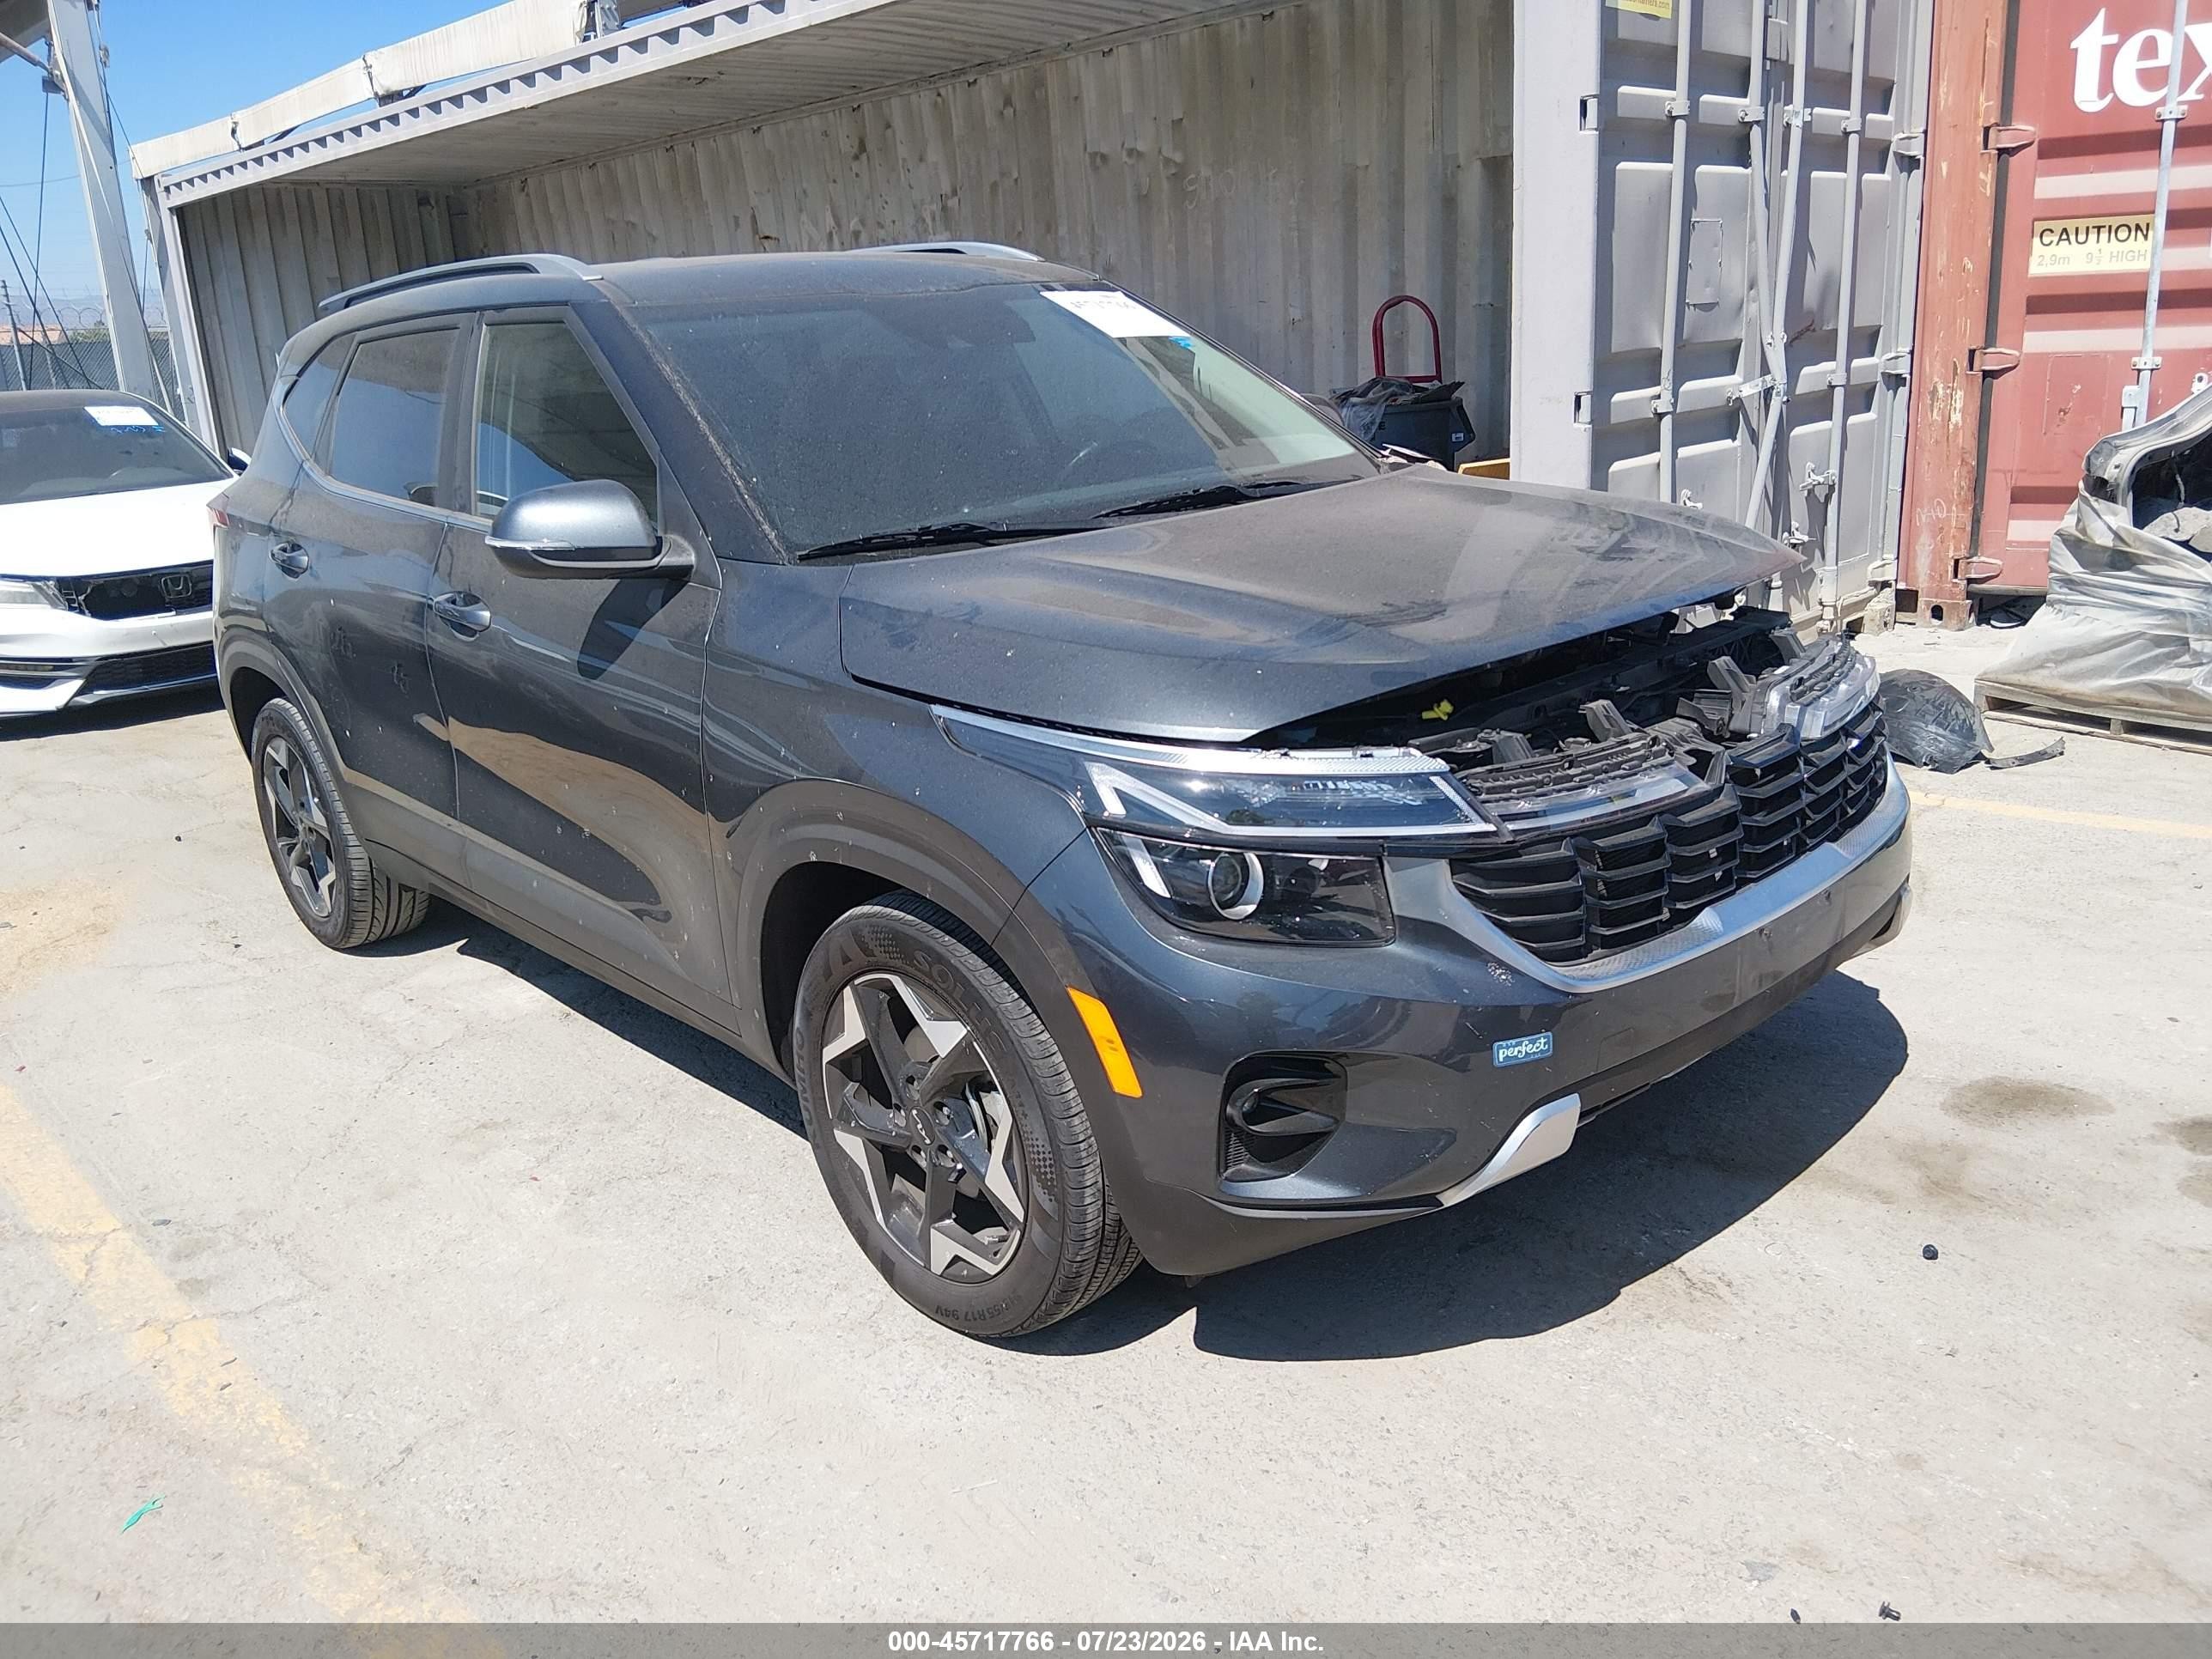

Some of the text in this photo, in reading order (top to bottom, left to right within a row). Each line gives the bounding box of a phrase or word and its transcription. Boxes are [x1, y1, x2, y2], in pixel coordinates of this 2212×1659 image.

[2039, 222, 2150, 246] CAUTION
[2037, 253, 2070, 268] 2,9m
[2109, 249, 2148, 264] HIGH
[1498, 1037, 1548, 1062] perfect
